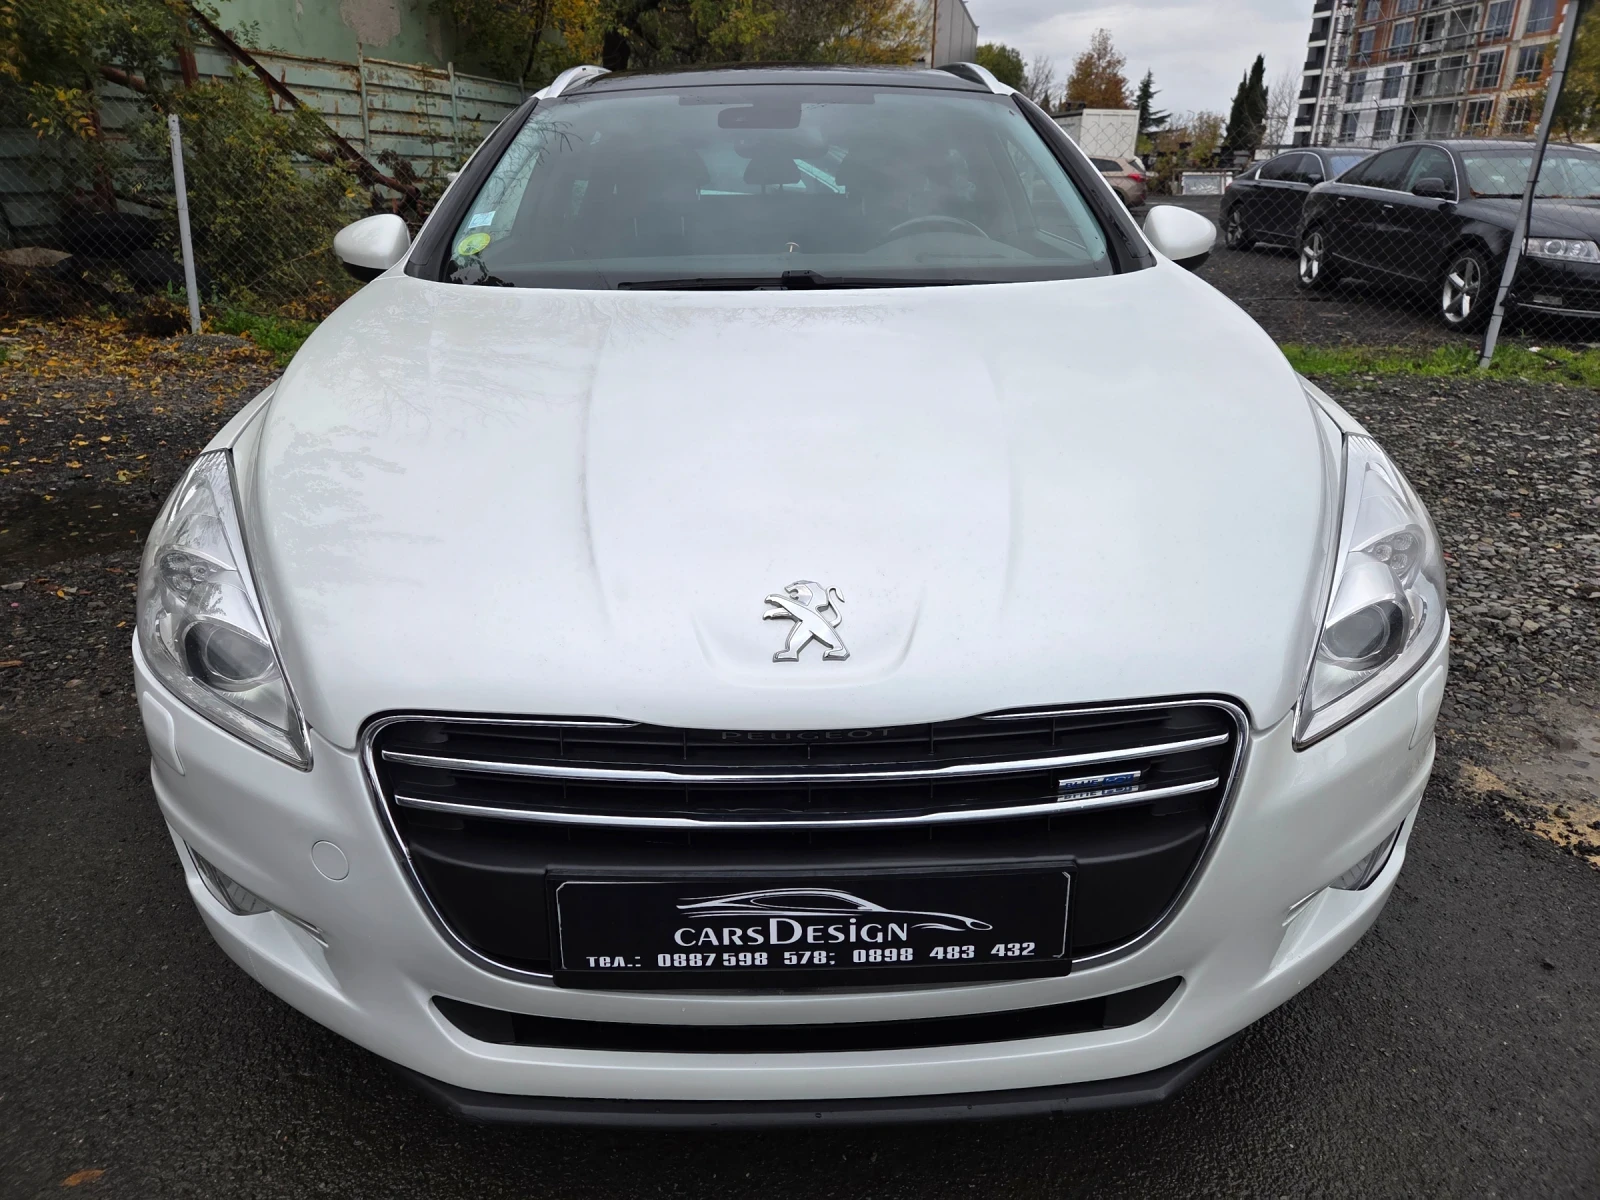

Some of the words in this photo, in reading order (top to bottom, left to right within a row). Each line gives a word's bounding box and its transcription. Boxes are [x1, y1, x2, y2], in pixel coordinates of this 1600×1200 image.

[721, 728, 896, 740] PEUGEOT
[1064, 779, 1100, 791] BLUE
[657, 953, 717, 967] 0887
[723, 952, 768, 966] 598
[853, 947, 914, 963] 0898
[929, 945, 976, 960] 483
[990, 942, 1036, 957] 432
